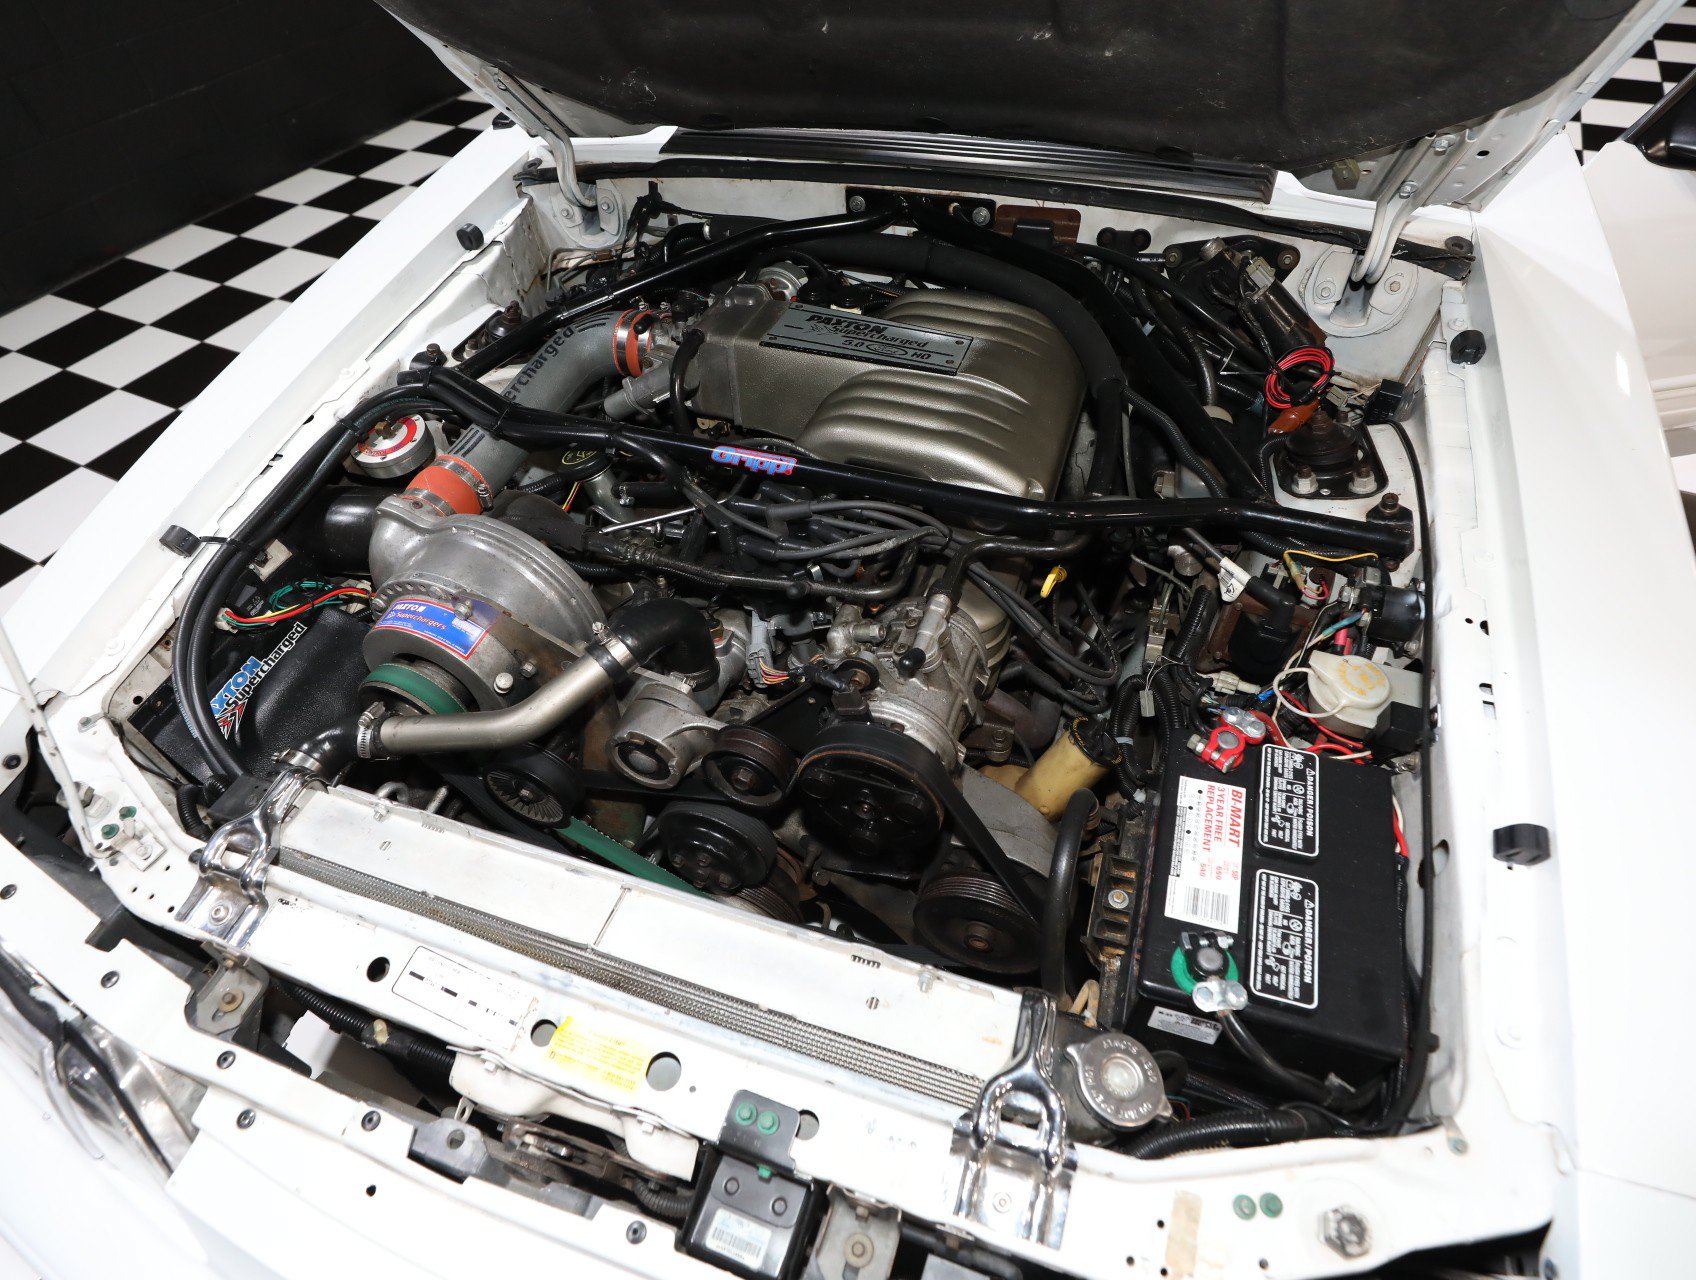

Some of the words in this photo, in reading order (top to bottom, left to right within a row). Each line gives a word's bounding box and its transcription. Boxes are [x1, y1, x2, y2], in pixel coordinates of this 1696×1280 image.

[805, 313, 889, 334] PAXTON
[832, 324, 929, 349] Supercharged
[842, 338, 865, 348] 5.0
[910, 351, 932, 361] HD
[503, 326, 575, 400] ercharged
[222, 621, 308, 710] Supercharged
[1202, 784, 1216, 852] REPLACEMENT
[1215, 793, 1225, 818] YEAR
[1229, 788, 1243, 848] BI-MART
[1213, 819, 1224, 842] FREE
